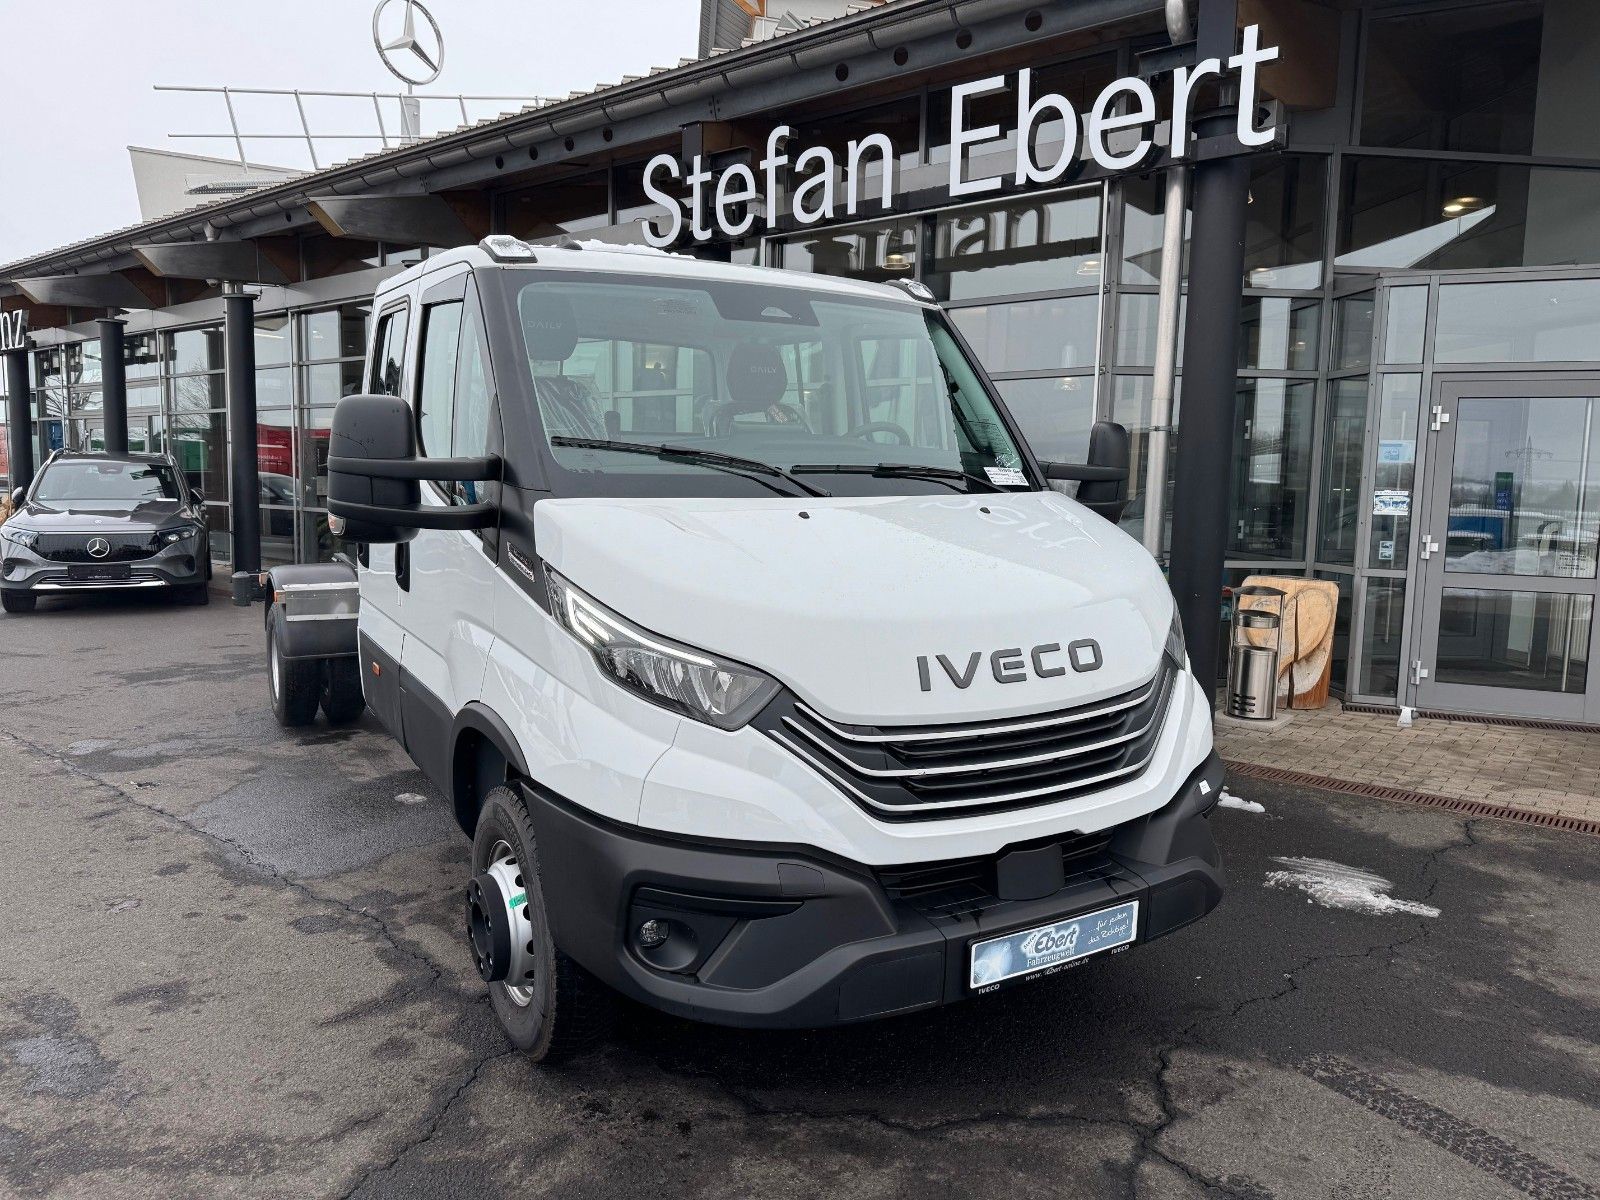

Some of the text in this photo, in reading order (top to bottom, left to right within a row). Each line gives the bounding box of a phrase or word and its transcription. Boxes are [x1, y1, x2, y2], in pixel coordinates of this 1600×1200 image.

[642, 23, 1279, 248] Stefan Ebert
[916, 638, 1104, 692] IVECO
[1034, 927, 1078, 954] Ebert
[1111, 944, 1130, 955] IVECO
[1026, 947, 1076, 968] Fahrzeugwelt
[978, 983, 1000, 995] IVECO
